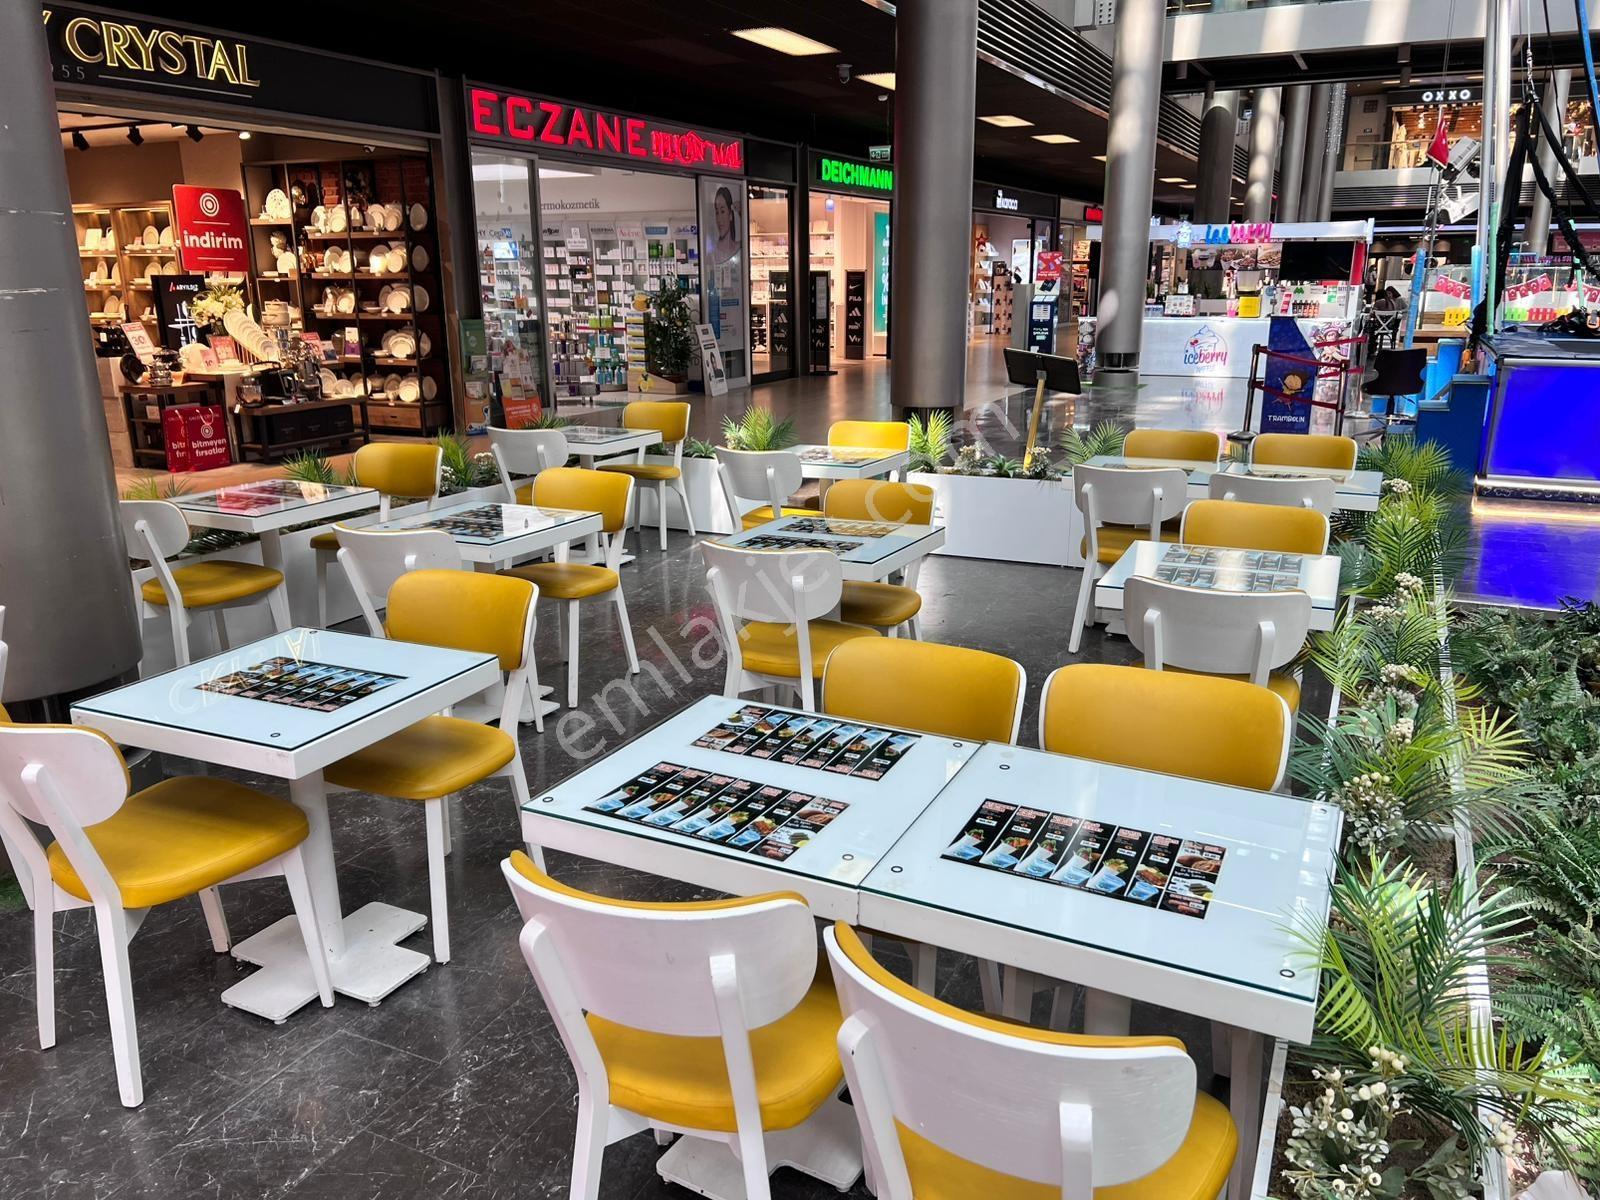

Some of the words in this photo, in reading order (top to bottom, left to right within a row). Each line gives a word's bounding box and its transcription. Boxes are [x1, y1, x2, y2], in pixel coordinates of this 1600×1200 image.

[65, 17, 260, 87] CRYSTAL
[1422, 89, 1471, 102] OXXO
[471, 88, 649, 157] ECZANE
[822, 158, 893, 191] DEICHMANN
[541, 198, 600, 211] ermokozmetik
[183, 230, 243, 249] indirim
[1183, 349, 1228, 366] iceberry
[191, 438, 227, 449] bitmeyen
[195, 446, 226, 457] fırsatlar
